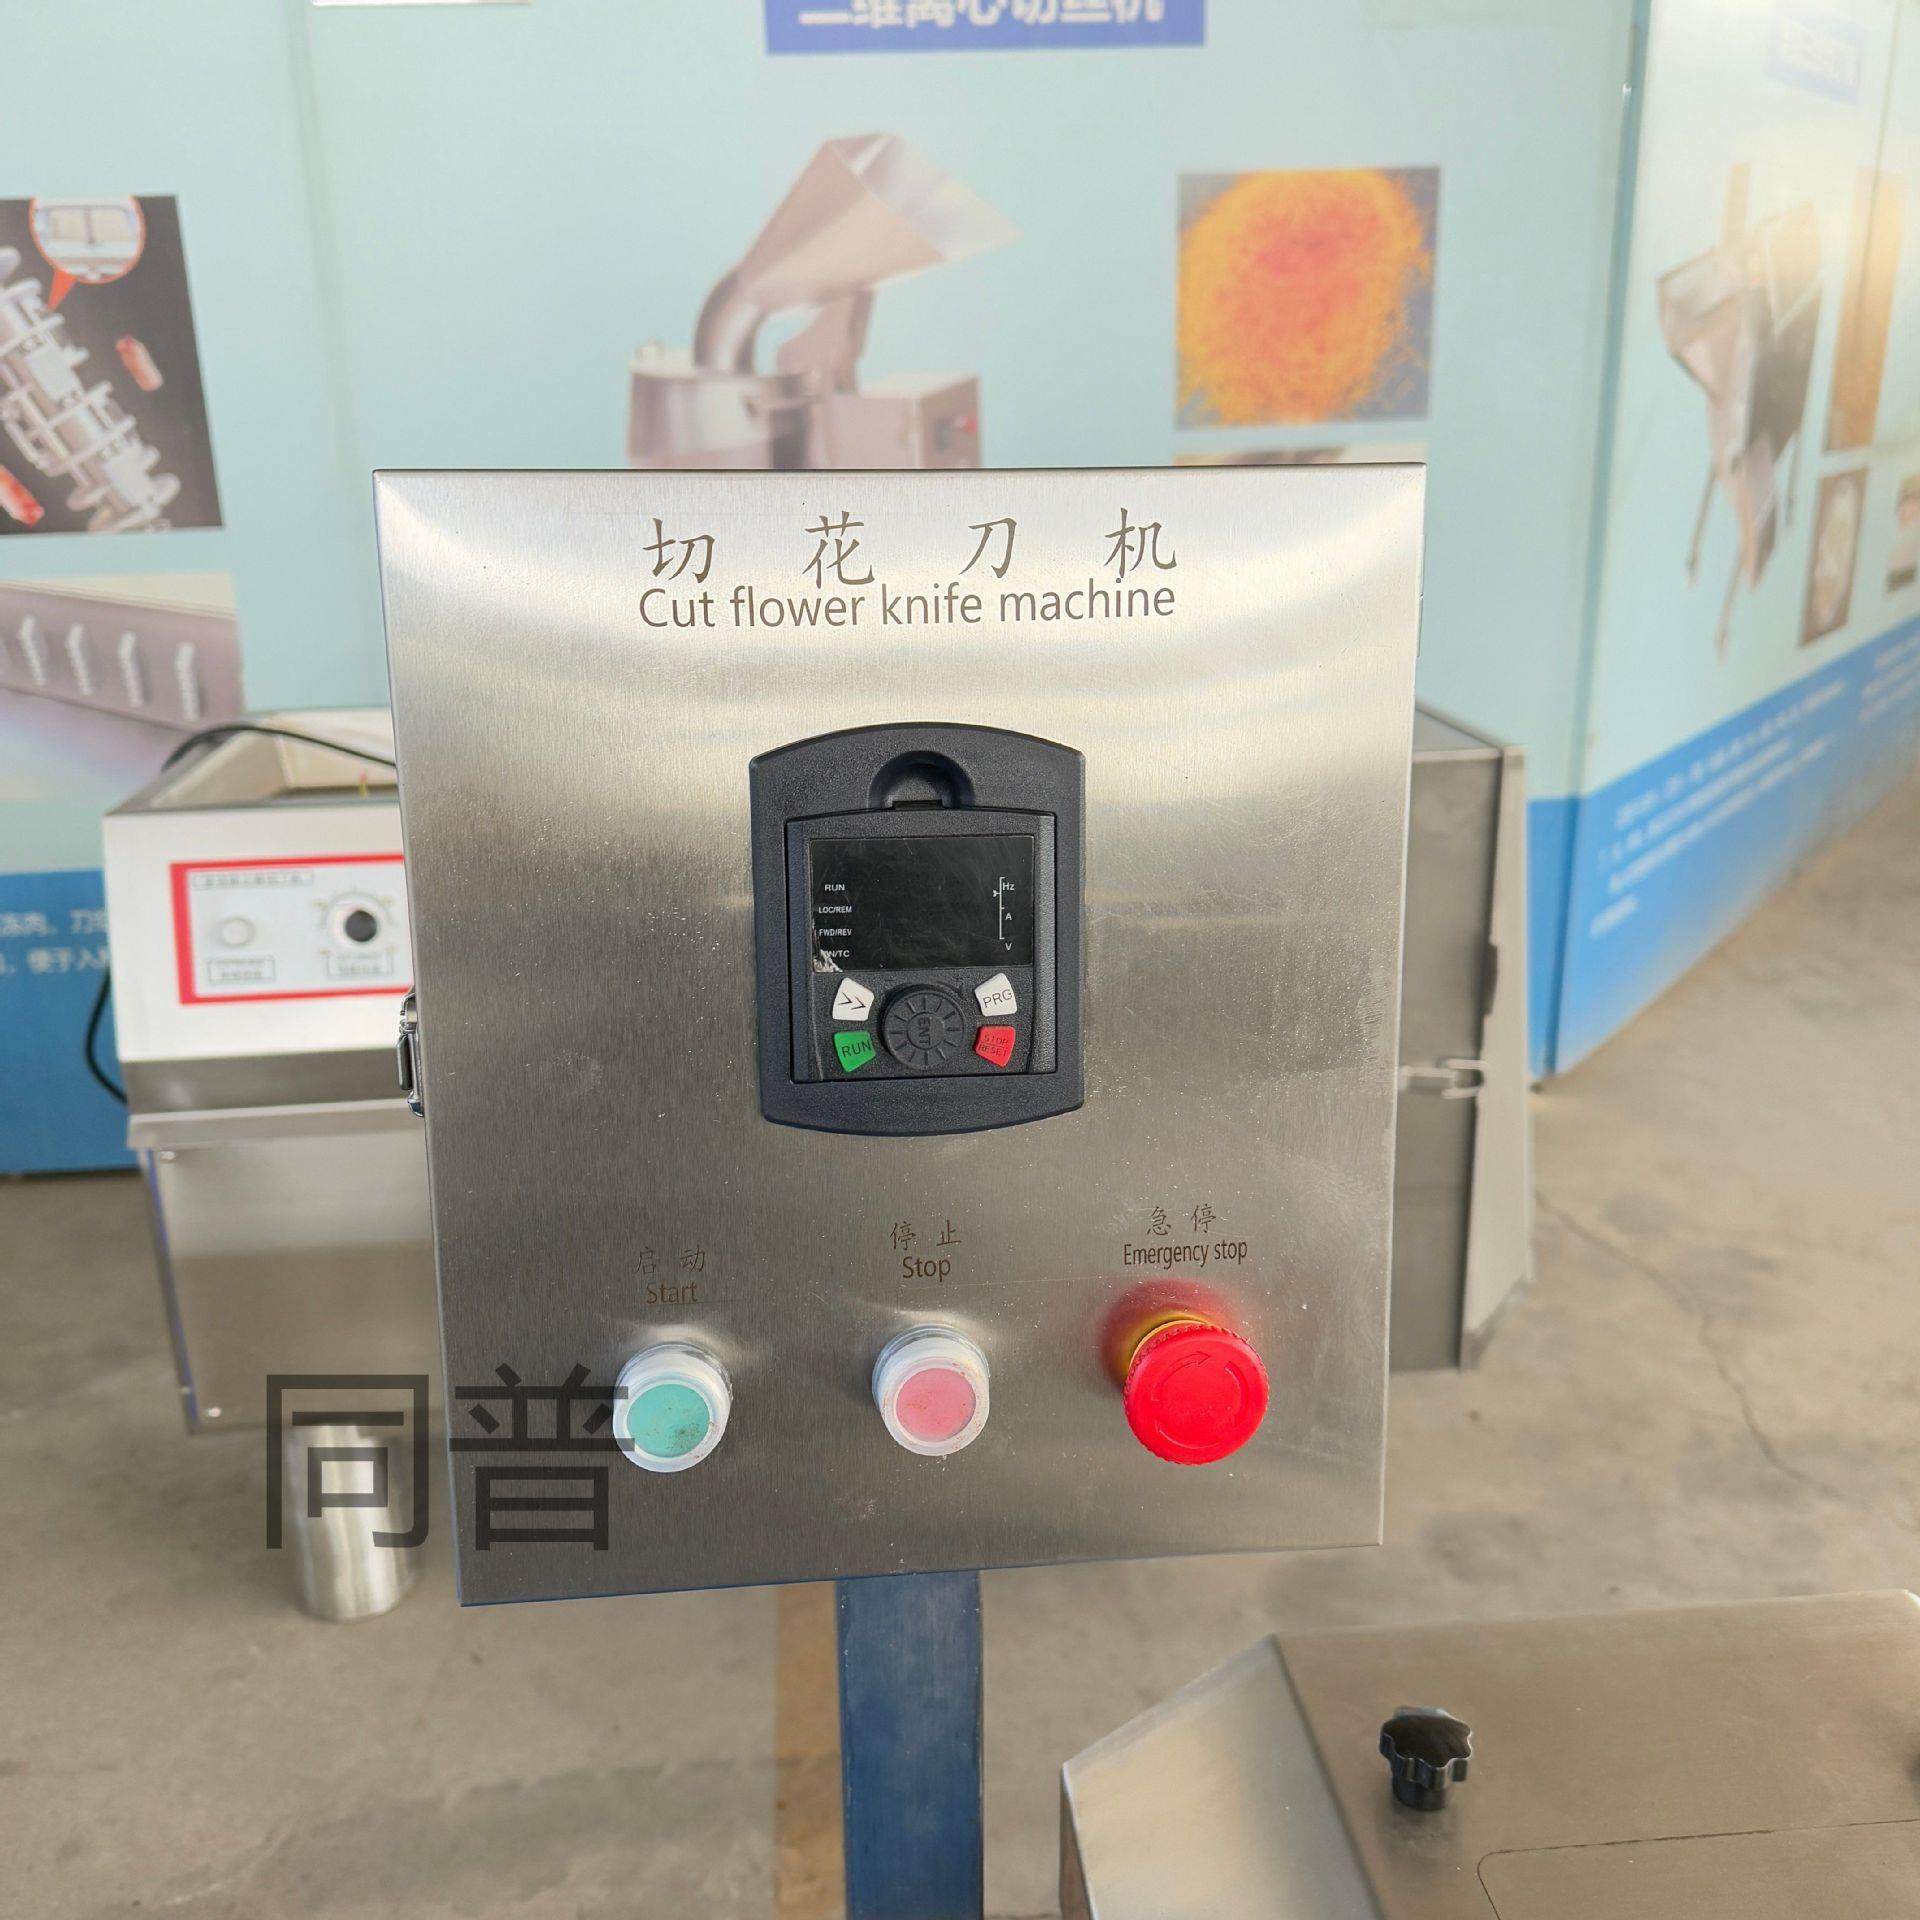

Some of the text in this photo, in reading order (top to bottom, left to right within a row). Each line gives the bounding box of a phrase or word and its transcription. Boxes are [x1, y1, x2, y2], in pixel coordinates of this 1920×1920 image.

[642, 508, 1177, 588] 切花刀机
[639, 578, 1175, 628] Cut flower knife machine
[824, 883, 846, 892] RUN
[1002, 882, 1015, 891] Hz
[818, 905, 853, 914] LOC/REM
[1005, 912, 1013, 921] A
[818, 928, 853, 937] FWD/REV
[1005, 942, 1013, 951] V
[983, 989, 1013, 1008] PRG
[984, 1033, 1009, 1046] STOP
[841, 1040, 872, 1058] RUN
[979, 1043, 1008, 1057] RESET
[1146, 1203, 1216, 1236] 急停
[889, 1220, 962, 1251] 停止
[637, 1243, 706, 1275] 启动
[1123, 1239, 1248, 1270] Emergency stop
[902, 1255, 951, 1283] Stop
[646, 1281, 698, 1304] Start
